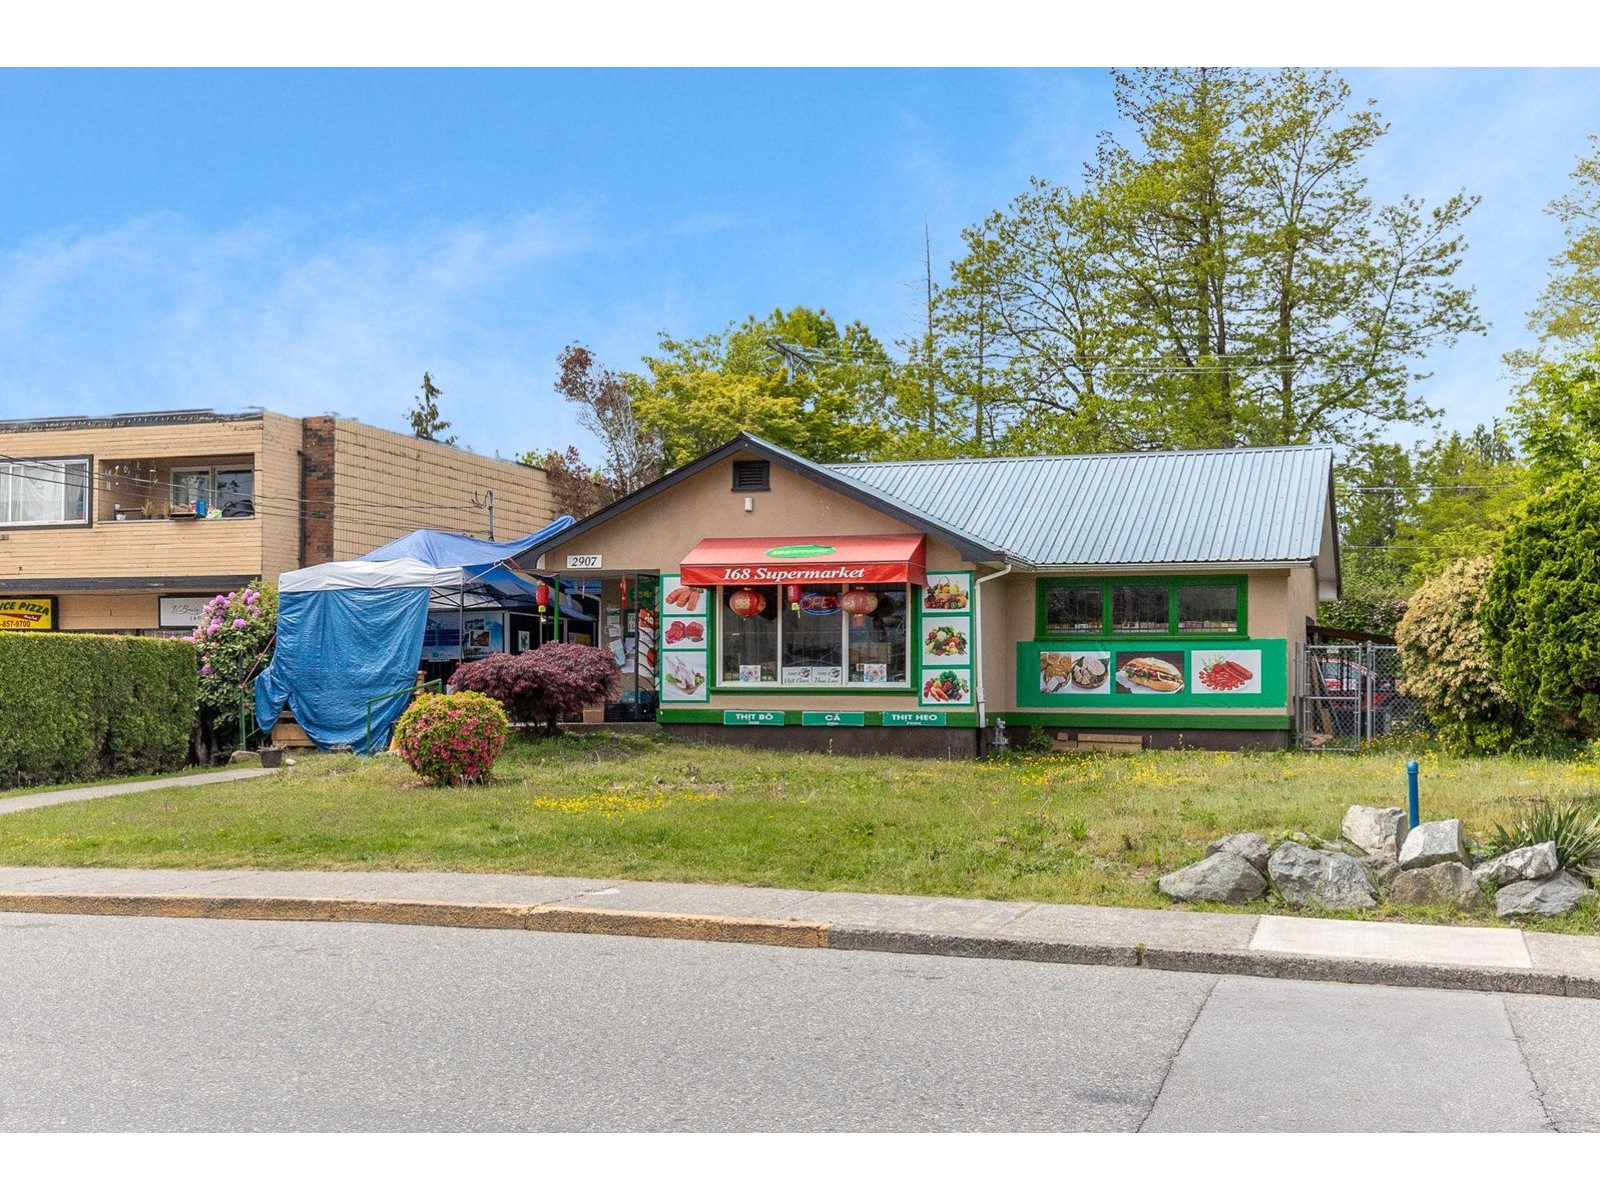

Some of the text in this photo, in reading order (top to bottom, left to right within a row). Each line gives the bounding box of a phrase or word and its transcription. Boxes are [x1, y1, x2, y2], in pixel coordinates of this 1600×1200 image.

[571, 556, 597, 567] 2907
[723, 567, 865, 582] 168 Supermarket
[18, 602, 49, 616] PIZZA
